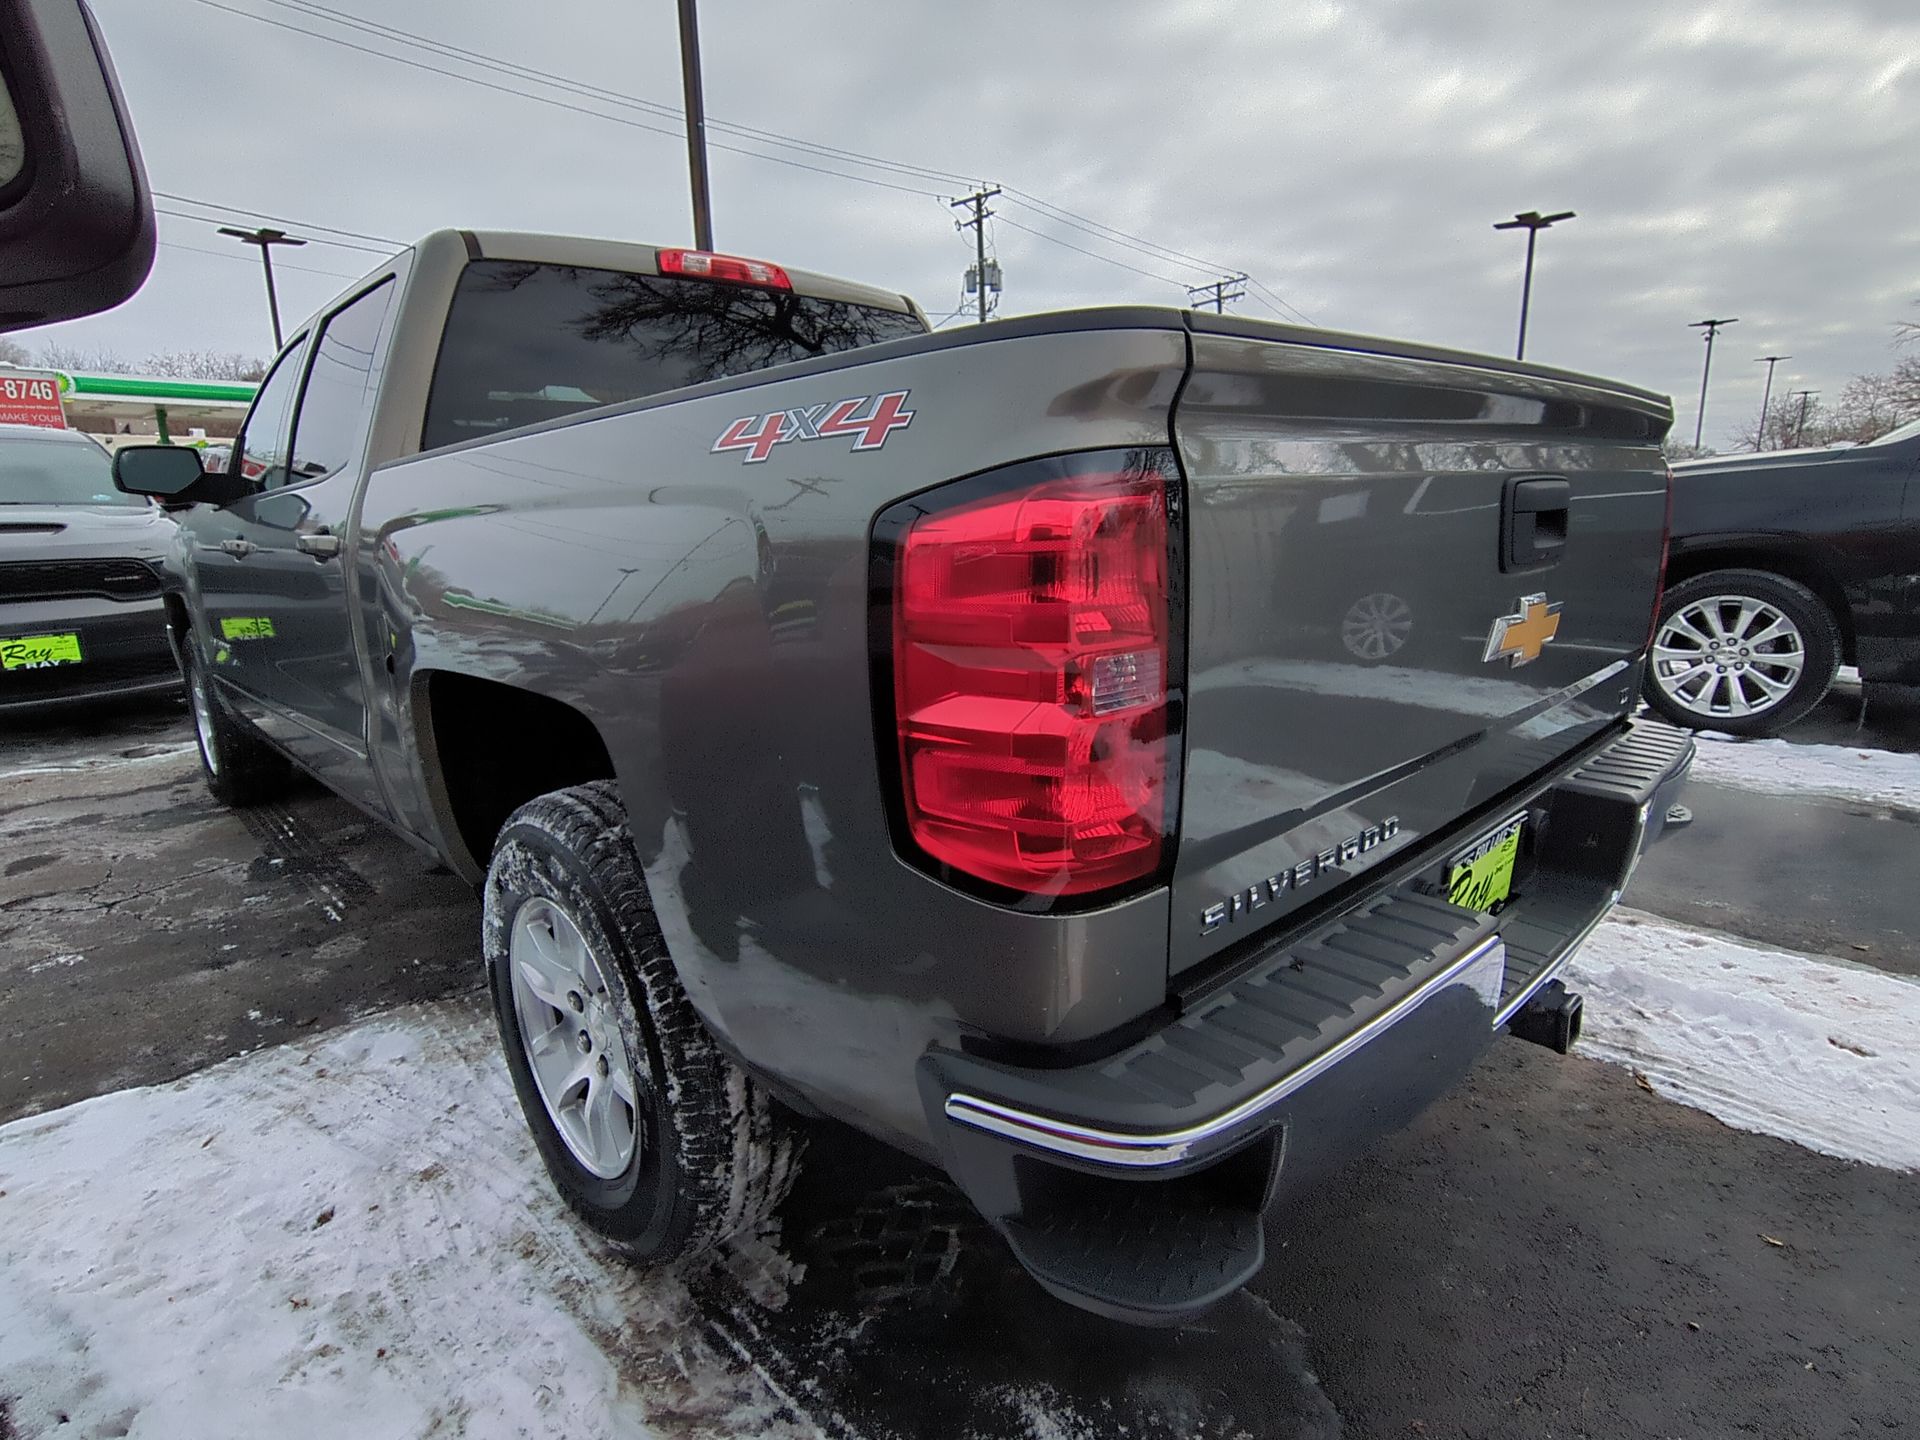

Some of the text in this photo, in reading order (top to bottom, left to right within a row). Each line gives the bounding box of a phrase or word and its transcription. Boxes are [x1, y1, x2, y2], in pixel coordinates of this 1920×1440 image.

[32, 414, 62, 423] YOUR
[2, 644, 54, 662] Ray
[1200, 815, 1400, 936] SILVERADO
